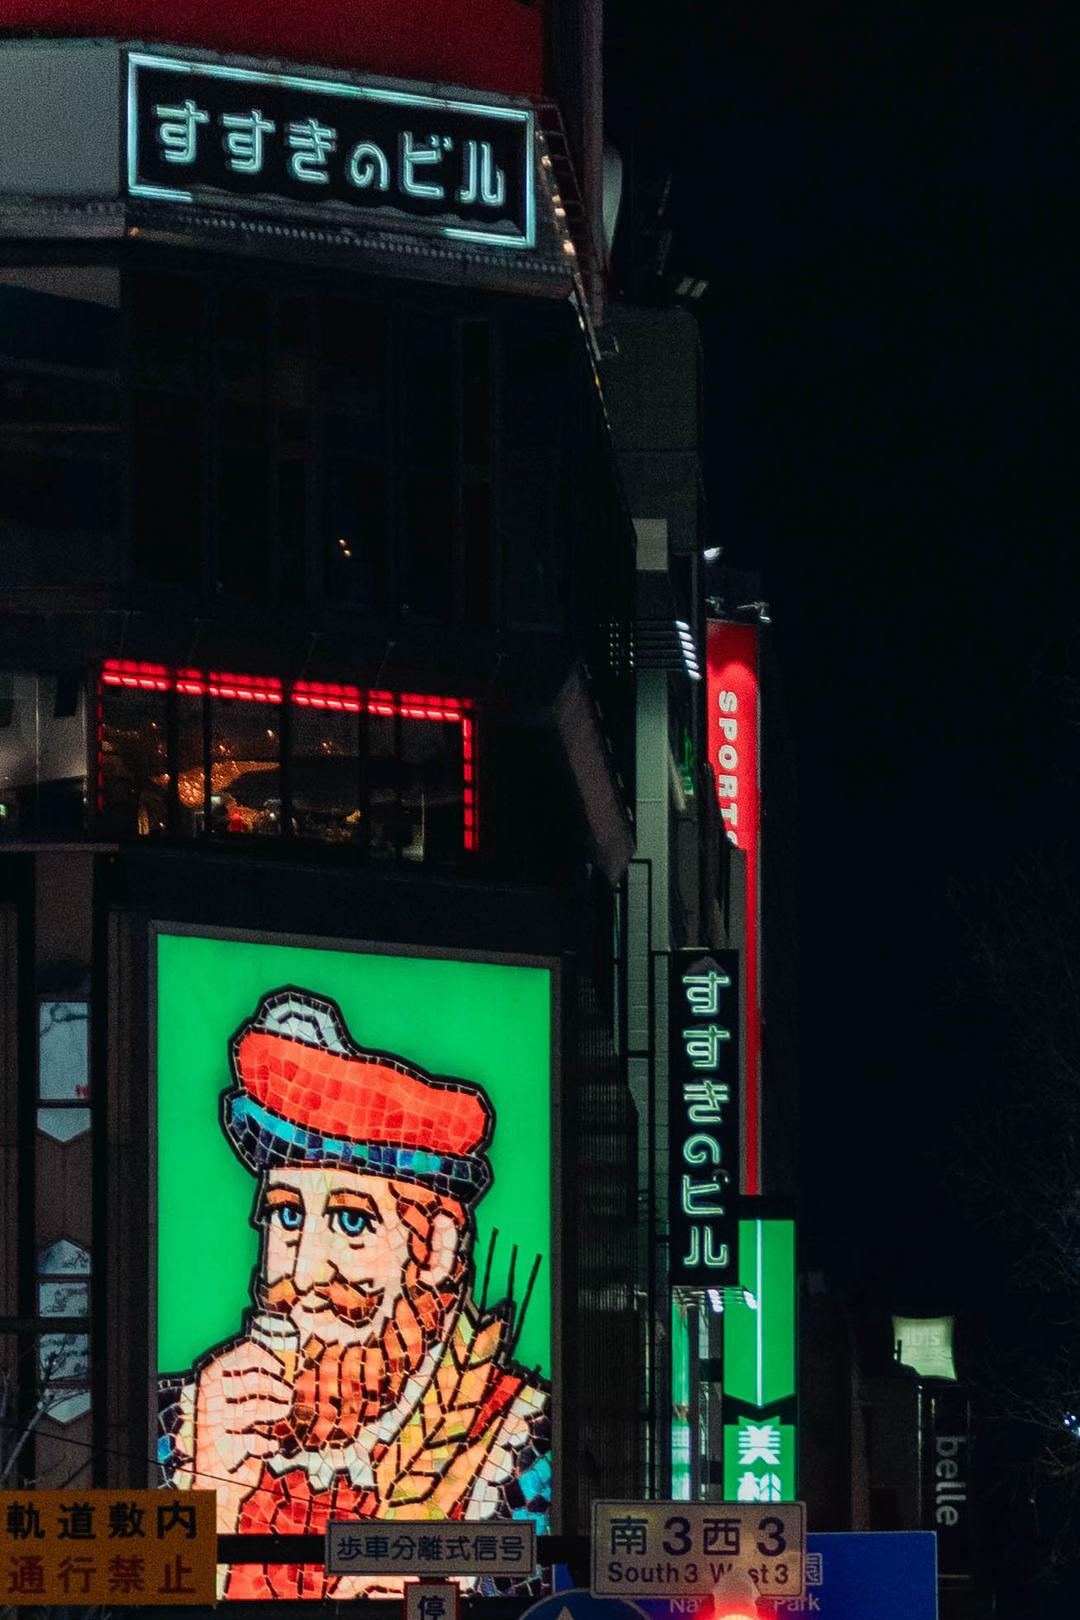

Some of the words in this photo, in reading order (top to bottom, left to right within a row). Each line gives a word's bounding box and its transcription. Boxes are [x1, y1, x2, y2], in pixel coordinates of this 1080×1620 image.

[154, 99, 505, 206] すすきのビル
[680, 969, 731, 1268] すすきのビル
[6, 1501, 198, 1540] 軌道敷内
[337, 1535, 526, 1562] 歩車分離式信号
[7, 1554, 197, 1594] 通行禁止
[709, 1563, 769, 1585] Wst
